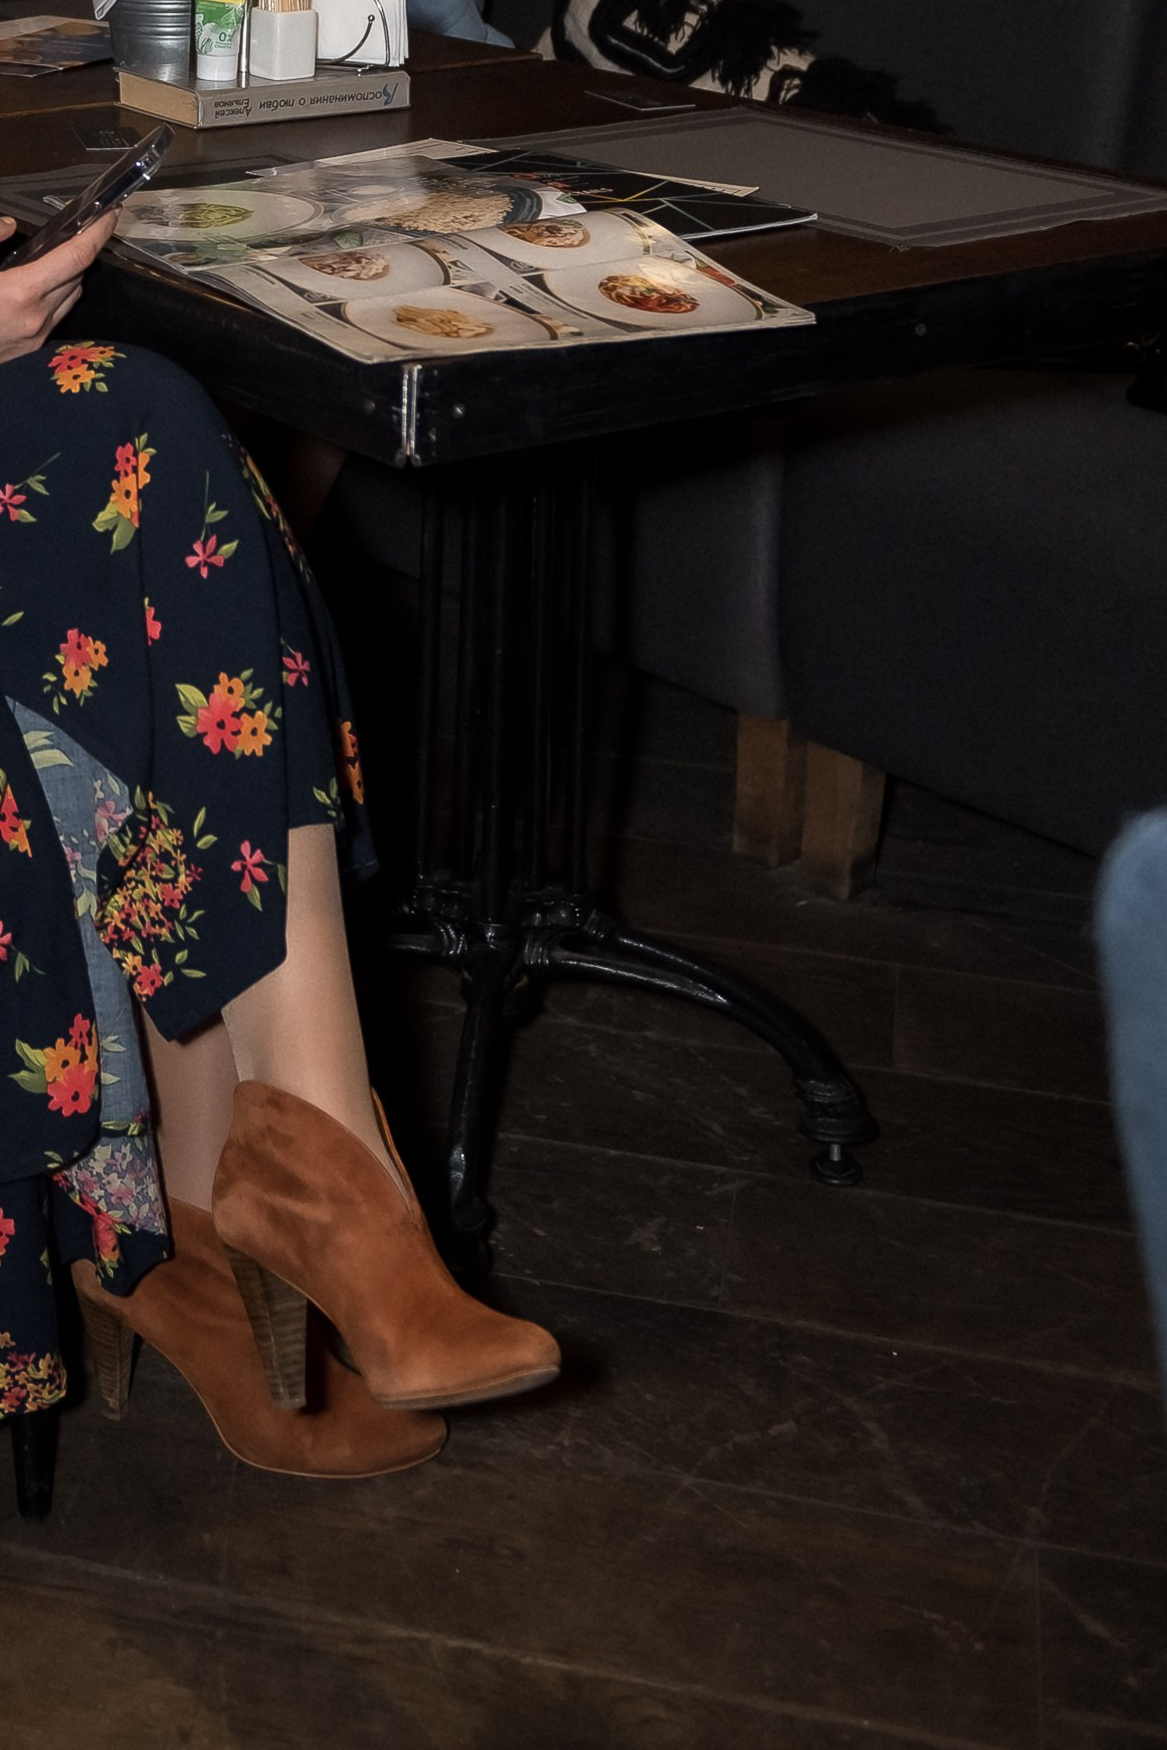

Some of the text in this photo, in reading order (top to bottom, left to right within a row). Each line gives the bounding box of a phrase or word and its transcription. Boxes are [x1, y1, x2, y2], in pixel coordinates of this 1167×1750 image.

[213, 98, 250, 109] Ельянов
[259, 82, 399, 111] Воспоминания о любви
[214, 105, 252, 119] Алексей
